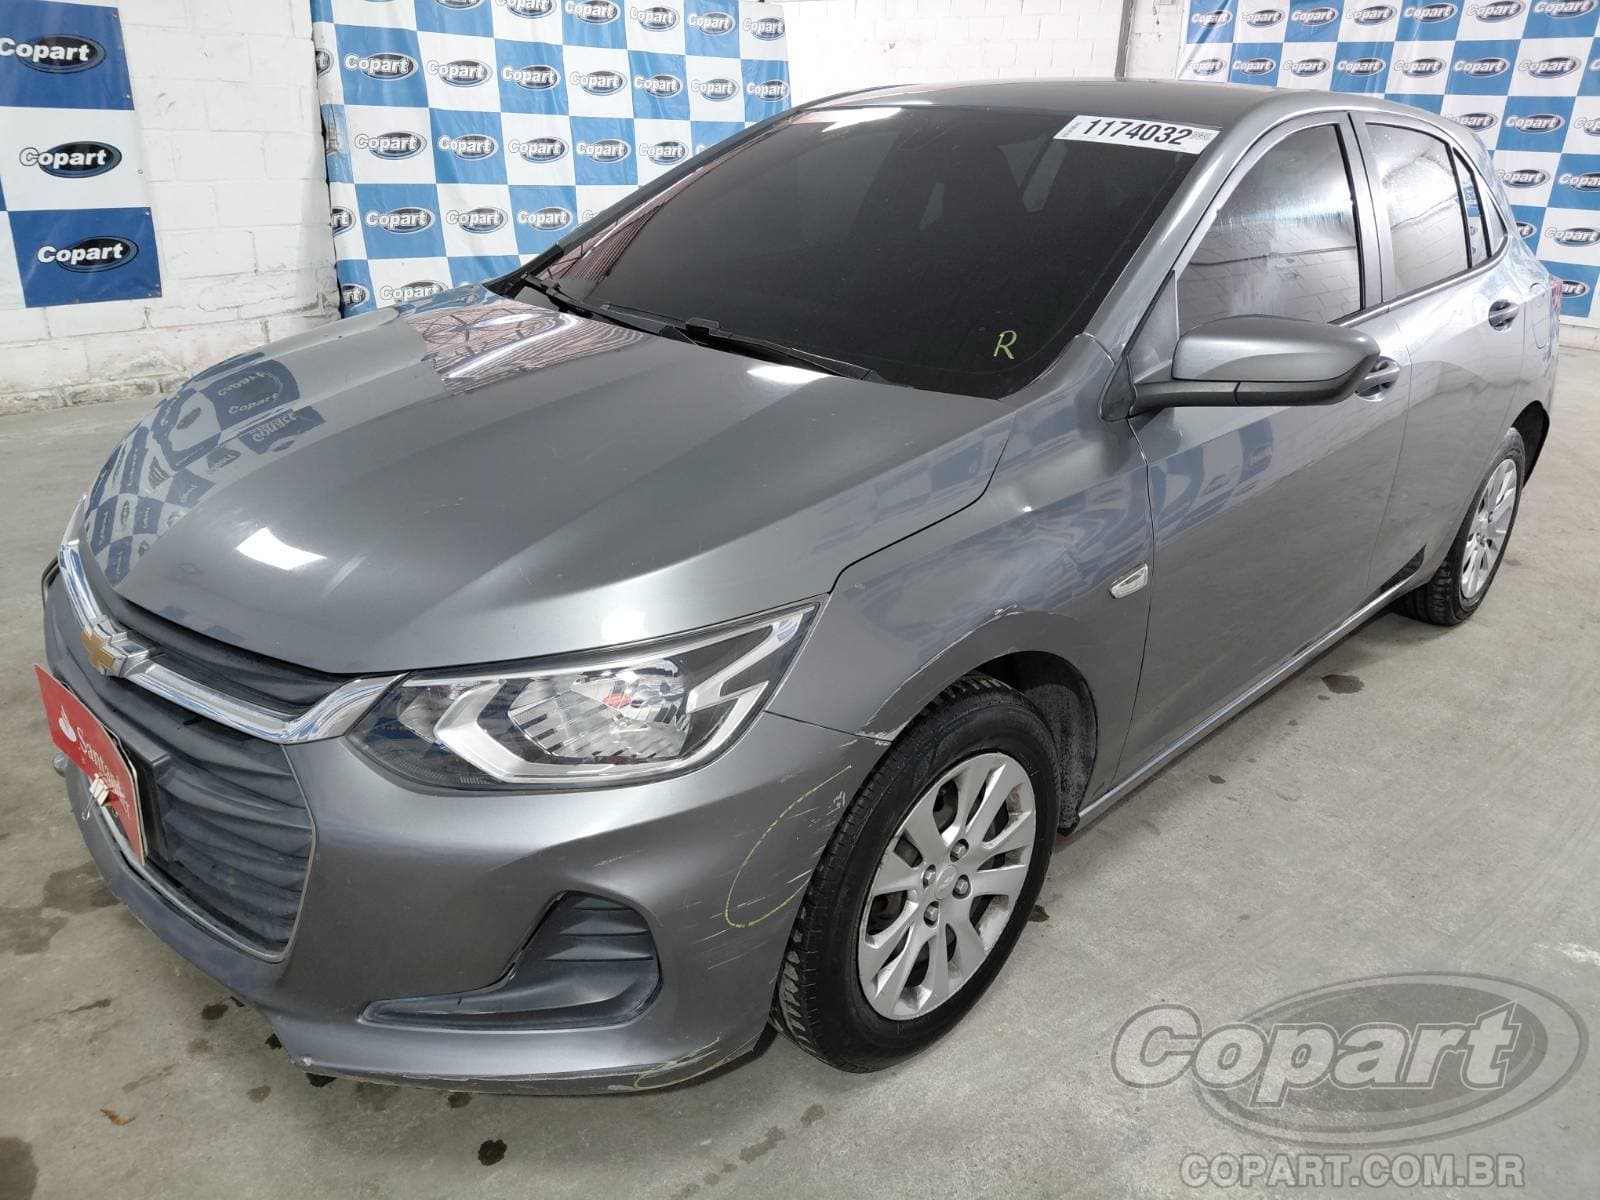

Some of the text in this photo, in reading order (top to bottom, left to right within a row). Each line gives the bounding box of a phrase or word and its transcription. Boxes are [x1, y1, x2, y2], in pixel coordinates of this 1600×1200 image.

[566, 1, 614, 16] Copart
[631, 7, 673, 24] Copart
[1347, 8, 1390, 22] Copart
[1405, 7, 1453, 19] Copart
[1467, 4, 1520, 17] Copart
[1534, 0, 1589, 14] Copart
[688, 14, 730, 31] Copart
[1292, 9, 1334, 23] Copart
[743, 18, 784, 36] Copart
[0, 37, 90, 61] Copart
[345, 54, 409, 72] Copart
[427, 60, 484, 78] Copart
[1233, 60, 1273, 73] Copart
[1283, 61, 1324, 74] Copart
[1337, 60, 1379, 73] Copart
[1394, 60, 1439, 73] Copart
[1454, 60, 1502, 73] Copart
[1519, 58, 1571, 73] Copart
[503, 67, 555, 84] Copart
[569, 71, 619, 90] Copart
[634, 76, 678, 93] Copart
[691, 80, 733, 96] Copart
[747, 83, 787, 98] Copart
[1505, 115, 1558, 129] Copart
[1083, 119, 1193, 146] 1174032
[355, 134, 418, 153] Copart
[439, 136, 492, 154] Copart
[509, 137, 562, 154] Copart
[576, 141, 625, 158] Copart
[639, 143, 683, 160] Copart
[20, 147, 108, 169] Copart
[366, 211, 427, 228] Copart
[446, 210, 500, 226] Copart
[518, 211, 568, 226] Copart
[1545, 227, 1597, 242] Copart
[37, 243, 124, 265] Copart
[993, 330, 1017, 360] R
